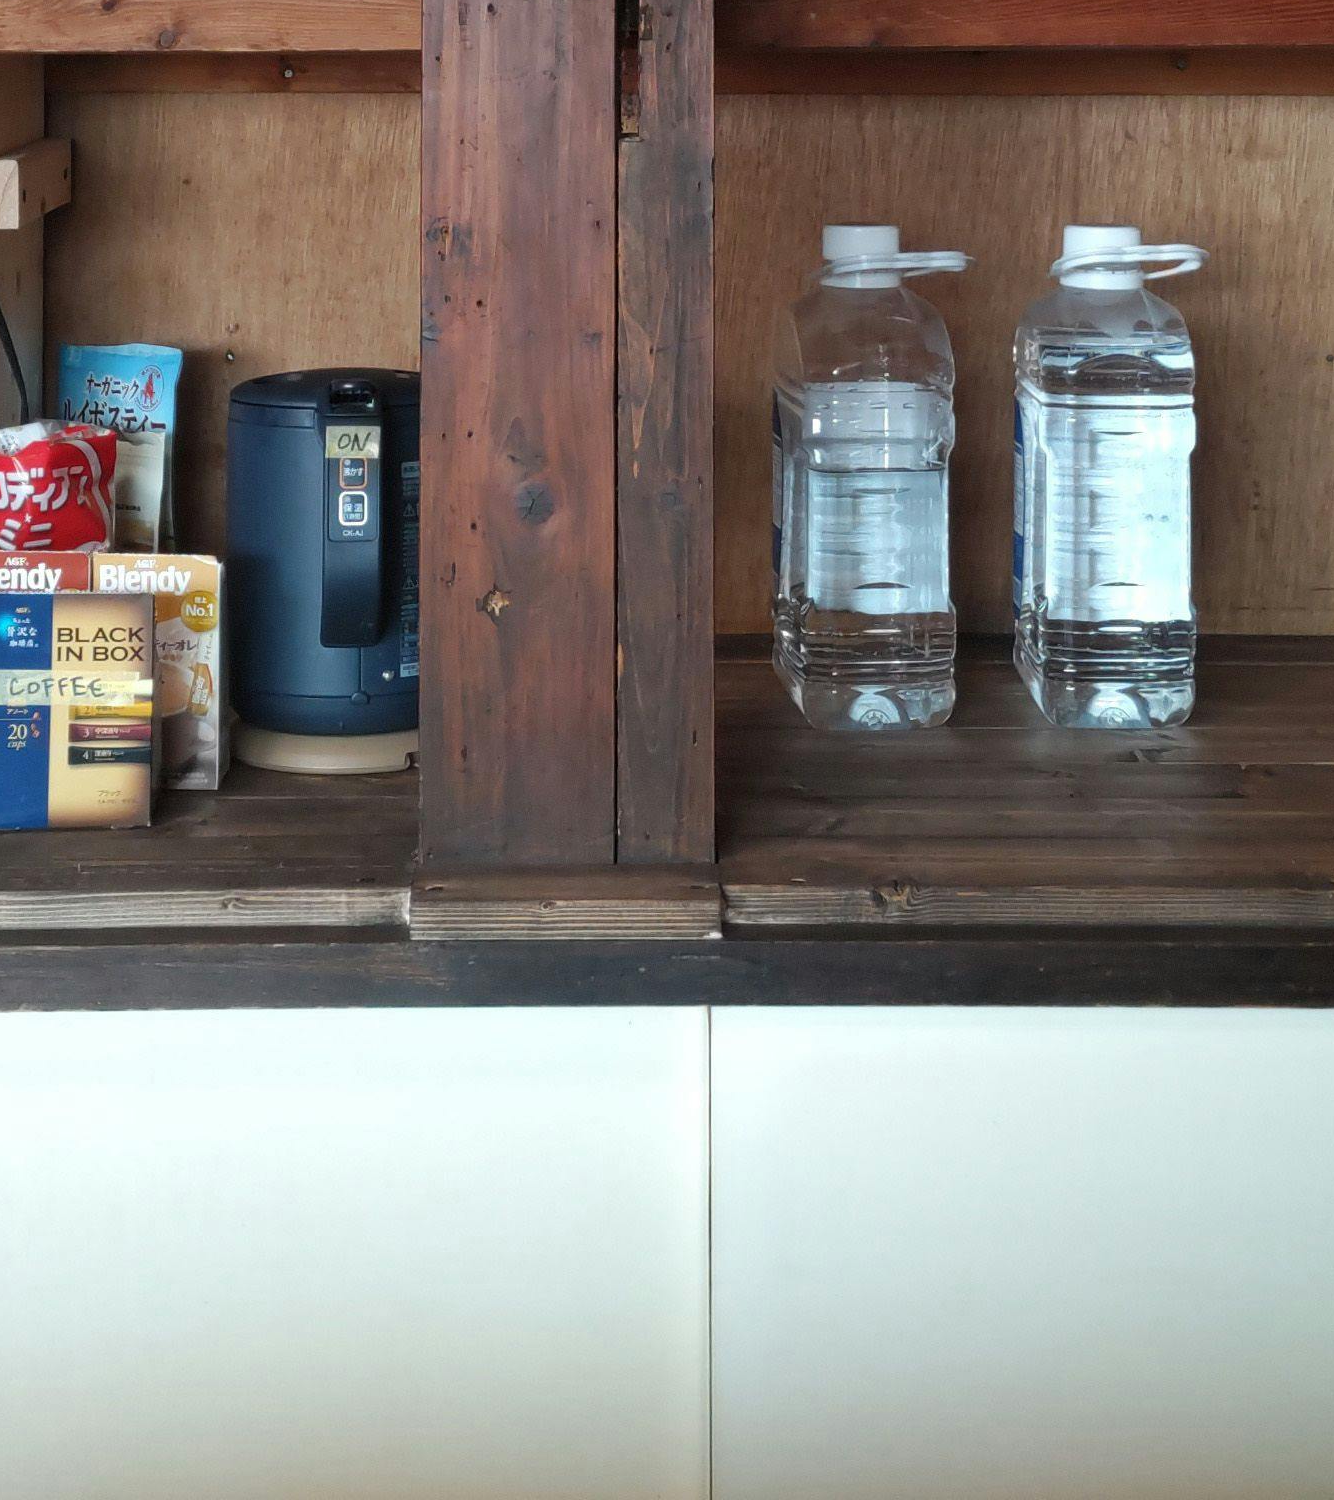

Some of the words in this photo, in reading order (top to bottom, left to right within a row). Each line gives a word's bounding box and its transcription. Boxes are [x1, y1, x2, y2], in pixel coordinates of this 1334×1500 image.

[86, 372, 139, 399] オーガニック
[63, 398, 166, 431] ルイボスティー
[338, 432, 371, 451] ON
[99, 564, 191, 594] Blendy
[186, 604, 214, 617] No.1
[7, 626, 38, 637] 贅沢な
[57, 627, 145, 642] BLACK
[57, 646, 83, 661] IN
[93, 646, 145, 661] BOX
[9, 676, 105, 698] COFFEE
[7, 724, 27, 740] 20
[83, 728, 90, 738] 3
[7, 742, 26, 751] cups
[82, 750, 89, 760] 4
